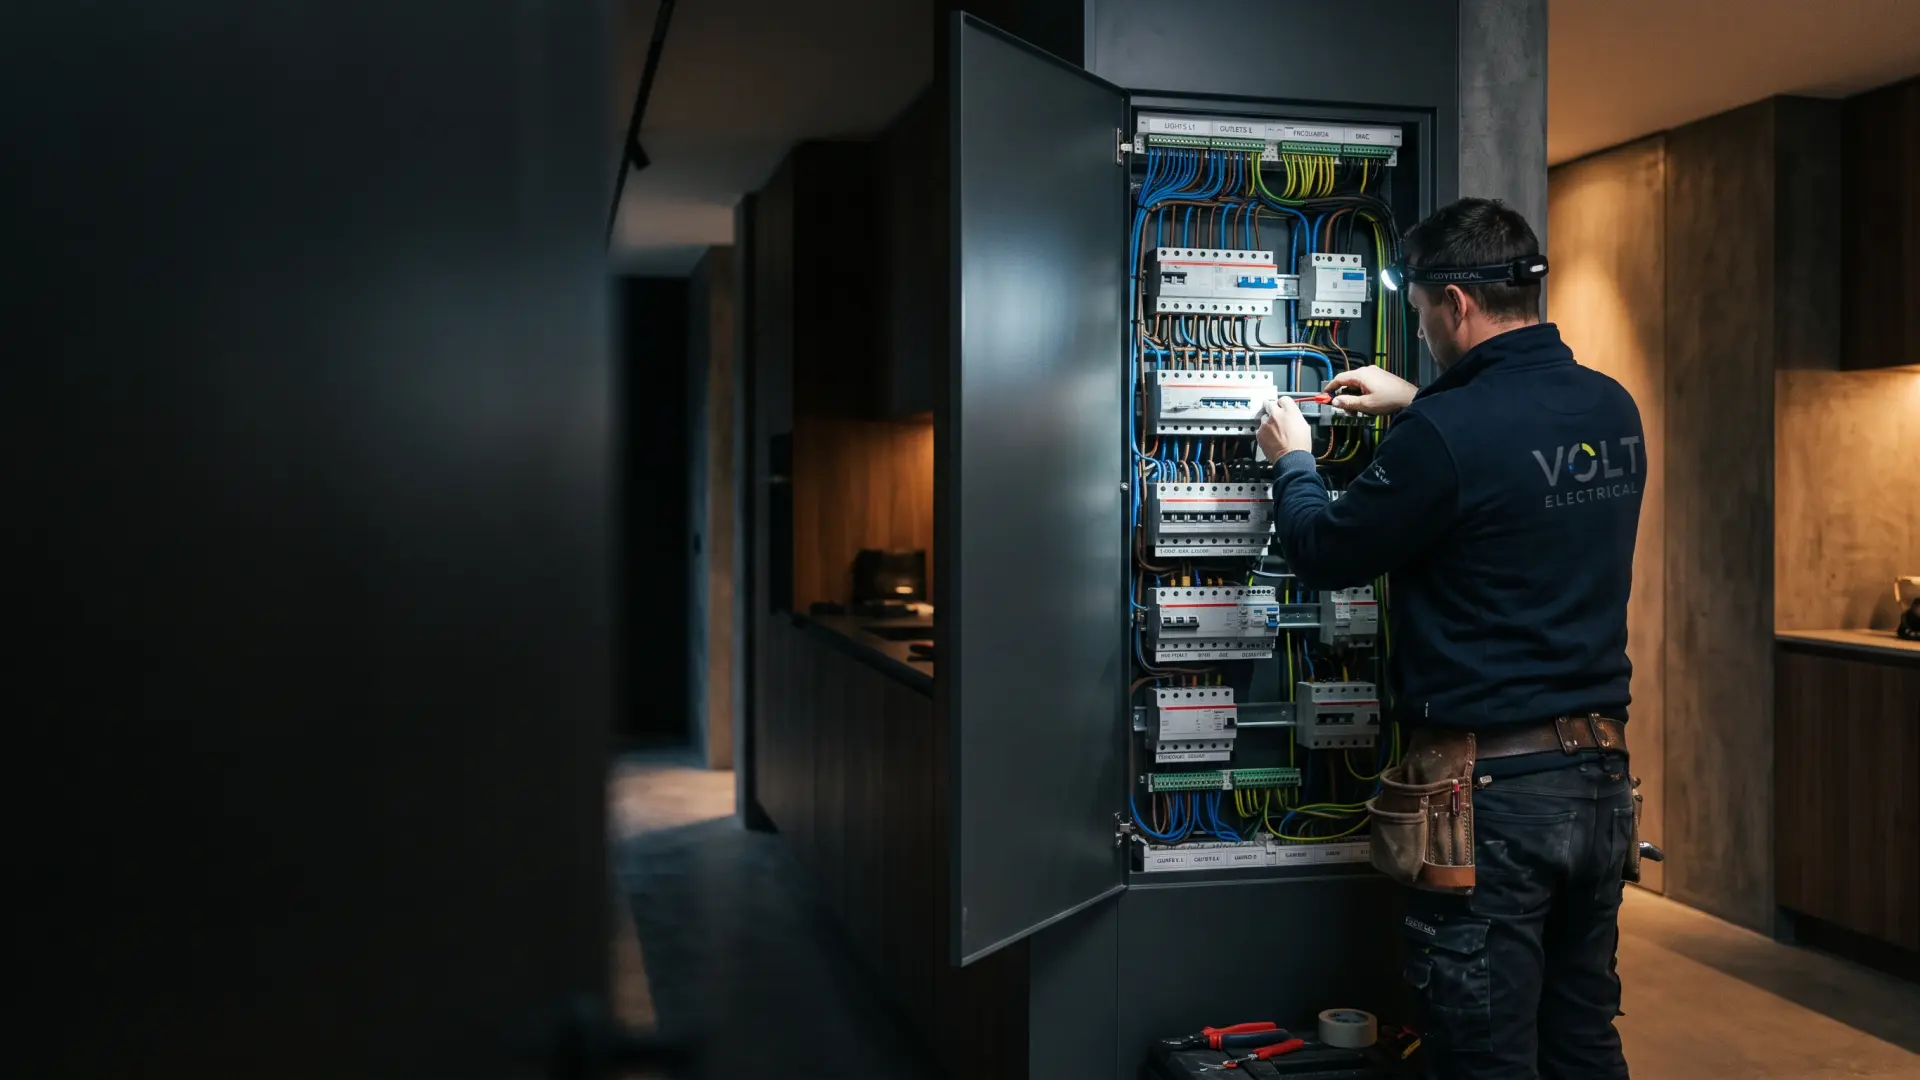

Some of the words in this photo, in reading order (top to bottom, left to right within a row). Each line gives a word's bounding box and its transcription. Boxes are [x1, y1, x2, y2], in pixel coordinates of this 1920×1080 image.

[1164, 122, 1187, 130] LIGHTS
[1532, 435, 1640, 487] VOLT
[1544, 482, 1639, 508] ELECTRICAL
